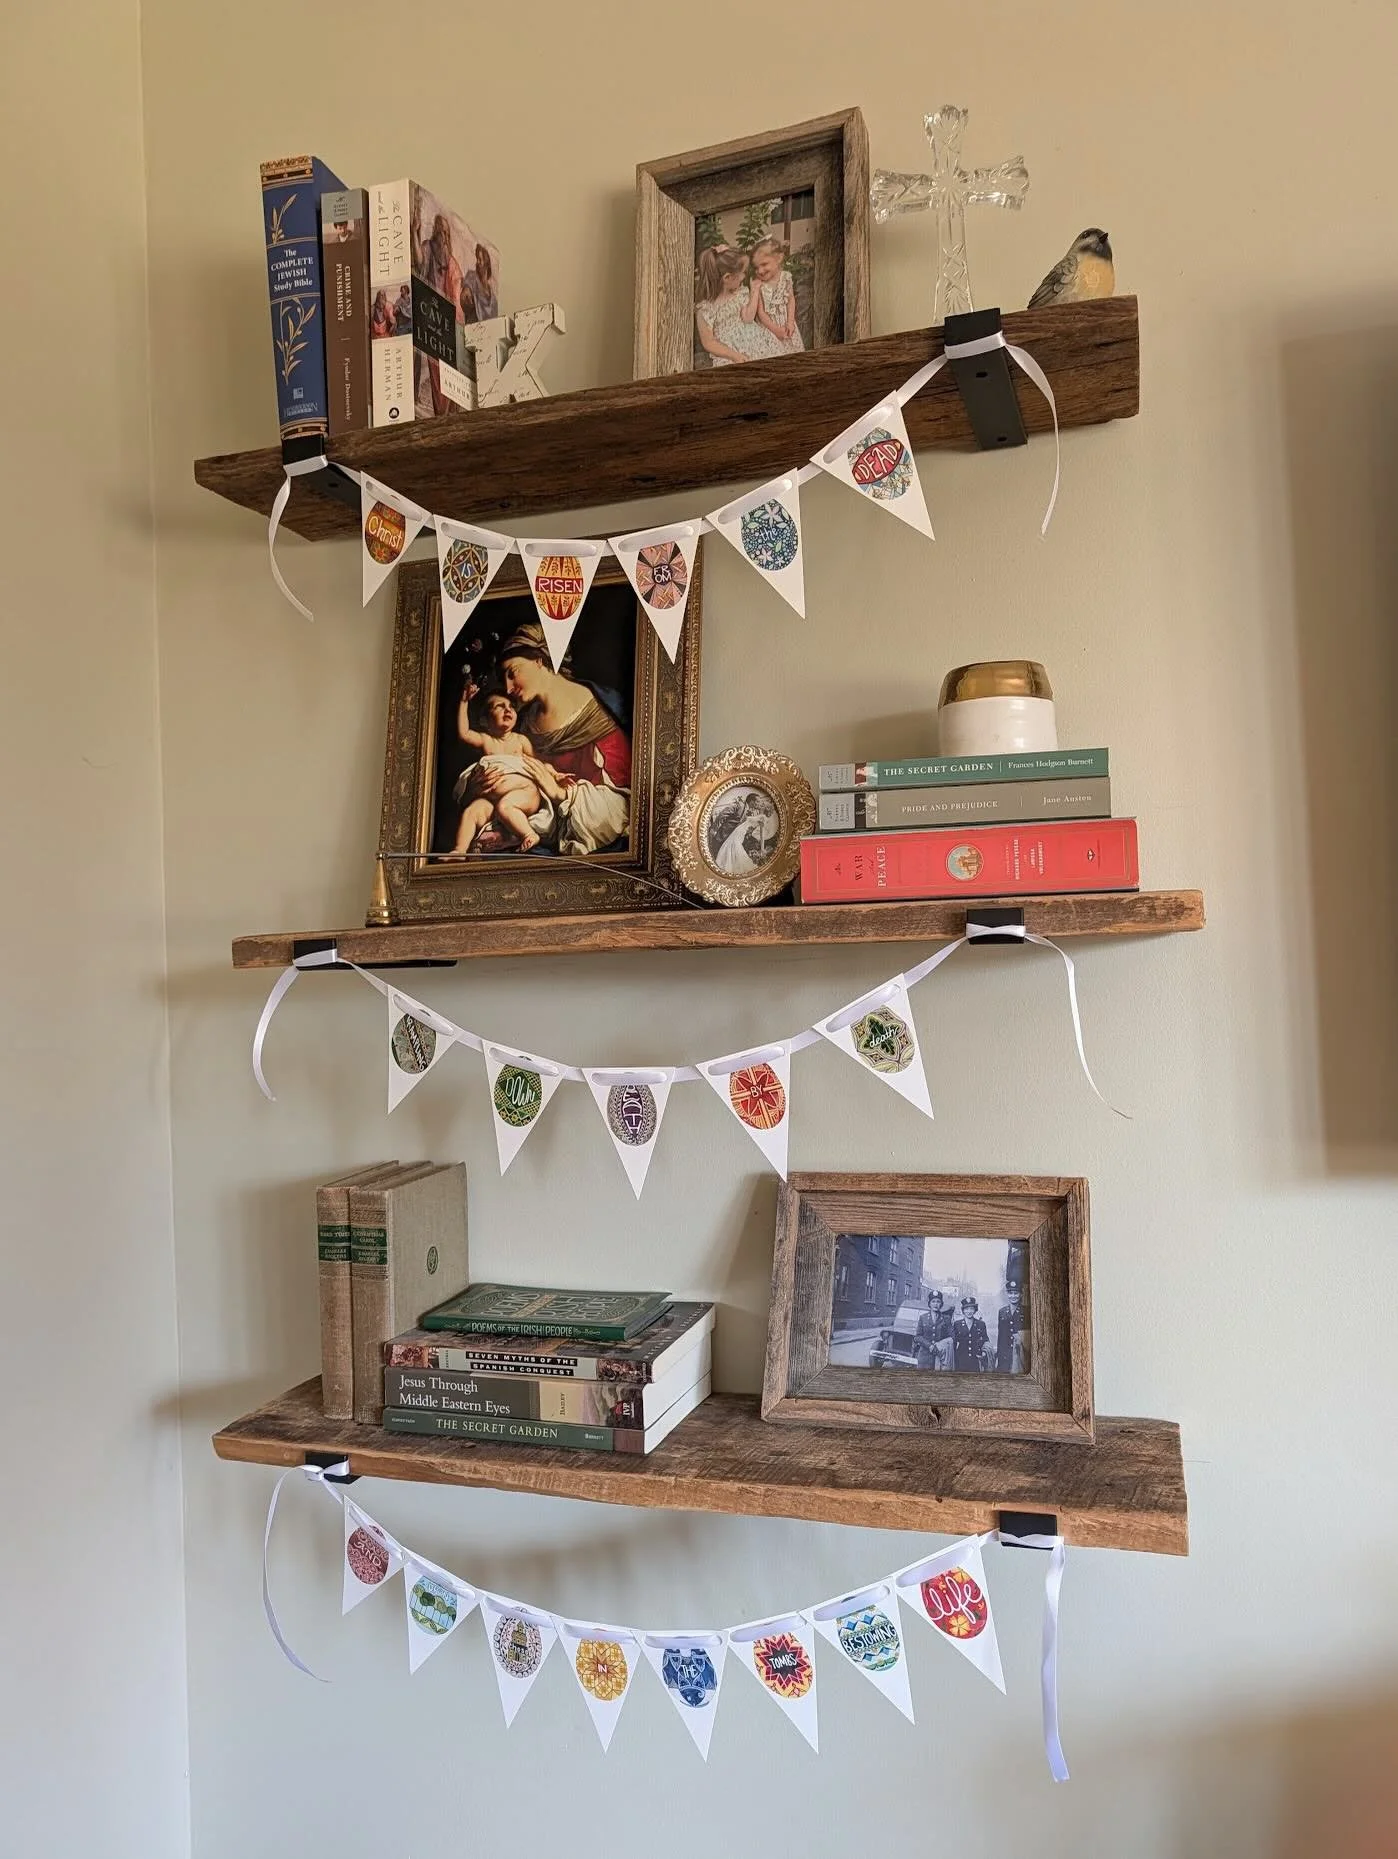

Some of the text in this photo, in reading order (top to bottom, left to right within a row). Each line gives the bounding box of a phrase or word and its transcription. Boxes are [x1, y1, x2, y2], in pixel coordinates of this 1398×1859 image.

[378, 216, 390, 276] LIGHT
[392, 215, 404, 264] CAVE
[284, 248, 297, 258] The
[270, 256, 314, 272] COMPLETE
[277, 268, 307, 282] JEWISH
[274, 278, 313, 293] Study Bible
[336, 263, 344, 322] PUNISHMENT
[420, 300, 450, 332] CAVE
[416, 326, 454, 362] LIGHT
[384, 348, 392, 401] HERMAN
[395, 348, 403, 399] ARTHUR
[857, 444, 898, 480] DEAD
[368, 515, 403, 548] Christ
[759, 527, 779, 541] the
[538, 578, 583, 593] RISEN
[884, 762, 994, 776] THE SECRET GARDEN
[1008, 756, 1094, 770] Frances Hodgson Burnett
[901, 800, 998, 814] PRIDE AND PREJUDICE
[1042, 794, 1092, 806] Jane Austen
[854, 854, 864, 882] WAR
[878, 846, 886, 888] PEACE
[869, 1026, 898, 1048] death
[750, 1086, 764, 1098] BY
[472, 1322, 497, 1334] POEMS
[520, 1324, 544, 1336] IRISH
[544, 1326, 573, 1338] PEOPLE
[468, 1352, 576, 1366] SEVEN MYTHS OF THE
[472, 1363, 572, 1376] SPANISH CONQUEST
[400, 1374, 479, 1395] Jesus Through
[400, 1392, 511, 1416] Middle Eastern Eyes
[622, 1402, 631, 1416] IVP
[436, 1418, 559, 1440] THE SECRET GARDEN
[929, 1576, 982, 1624] life
[842, 1622, 897, 1652] BESTOWING
[596, 1664, 608, 1673] IN
[768, 1653, 798, 1670] TOMBS
[681, 1664, 698, 1679] THE
